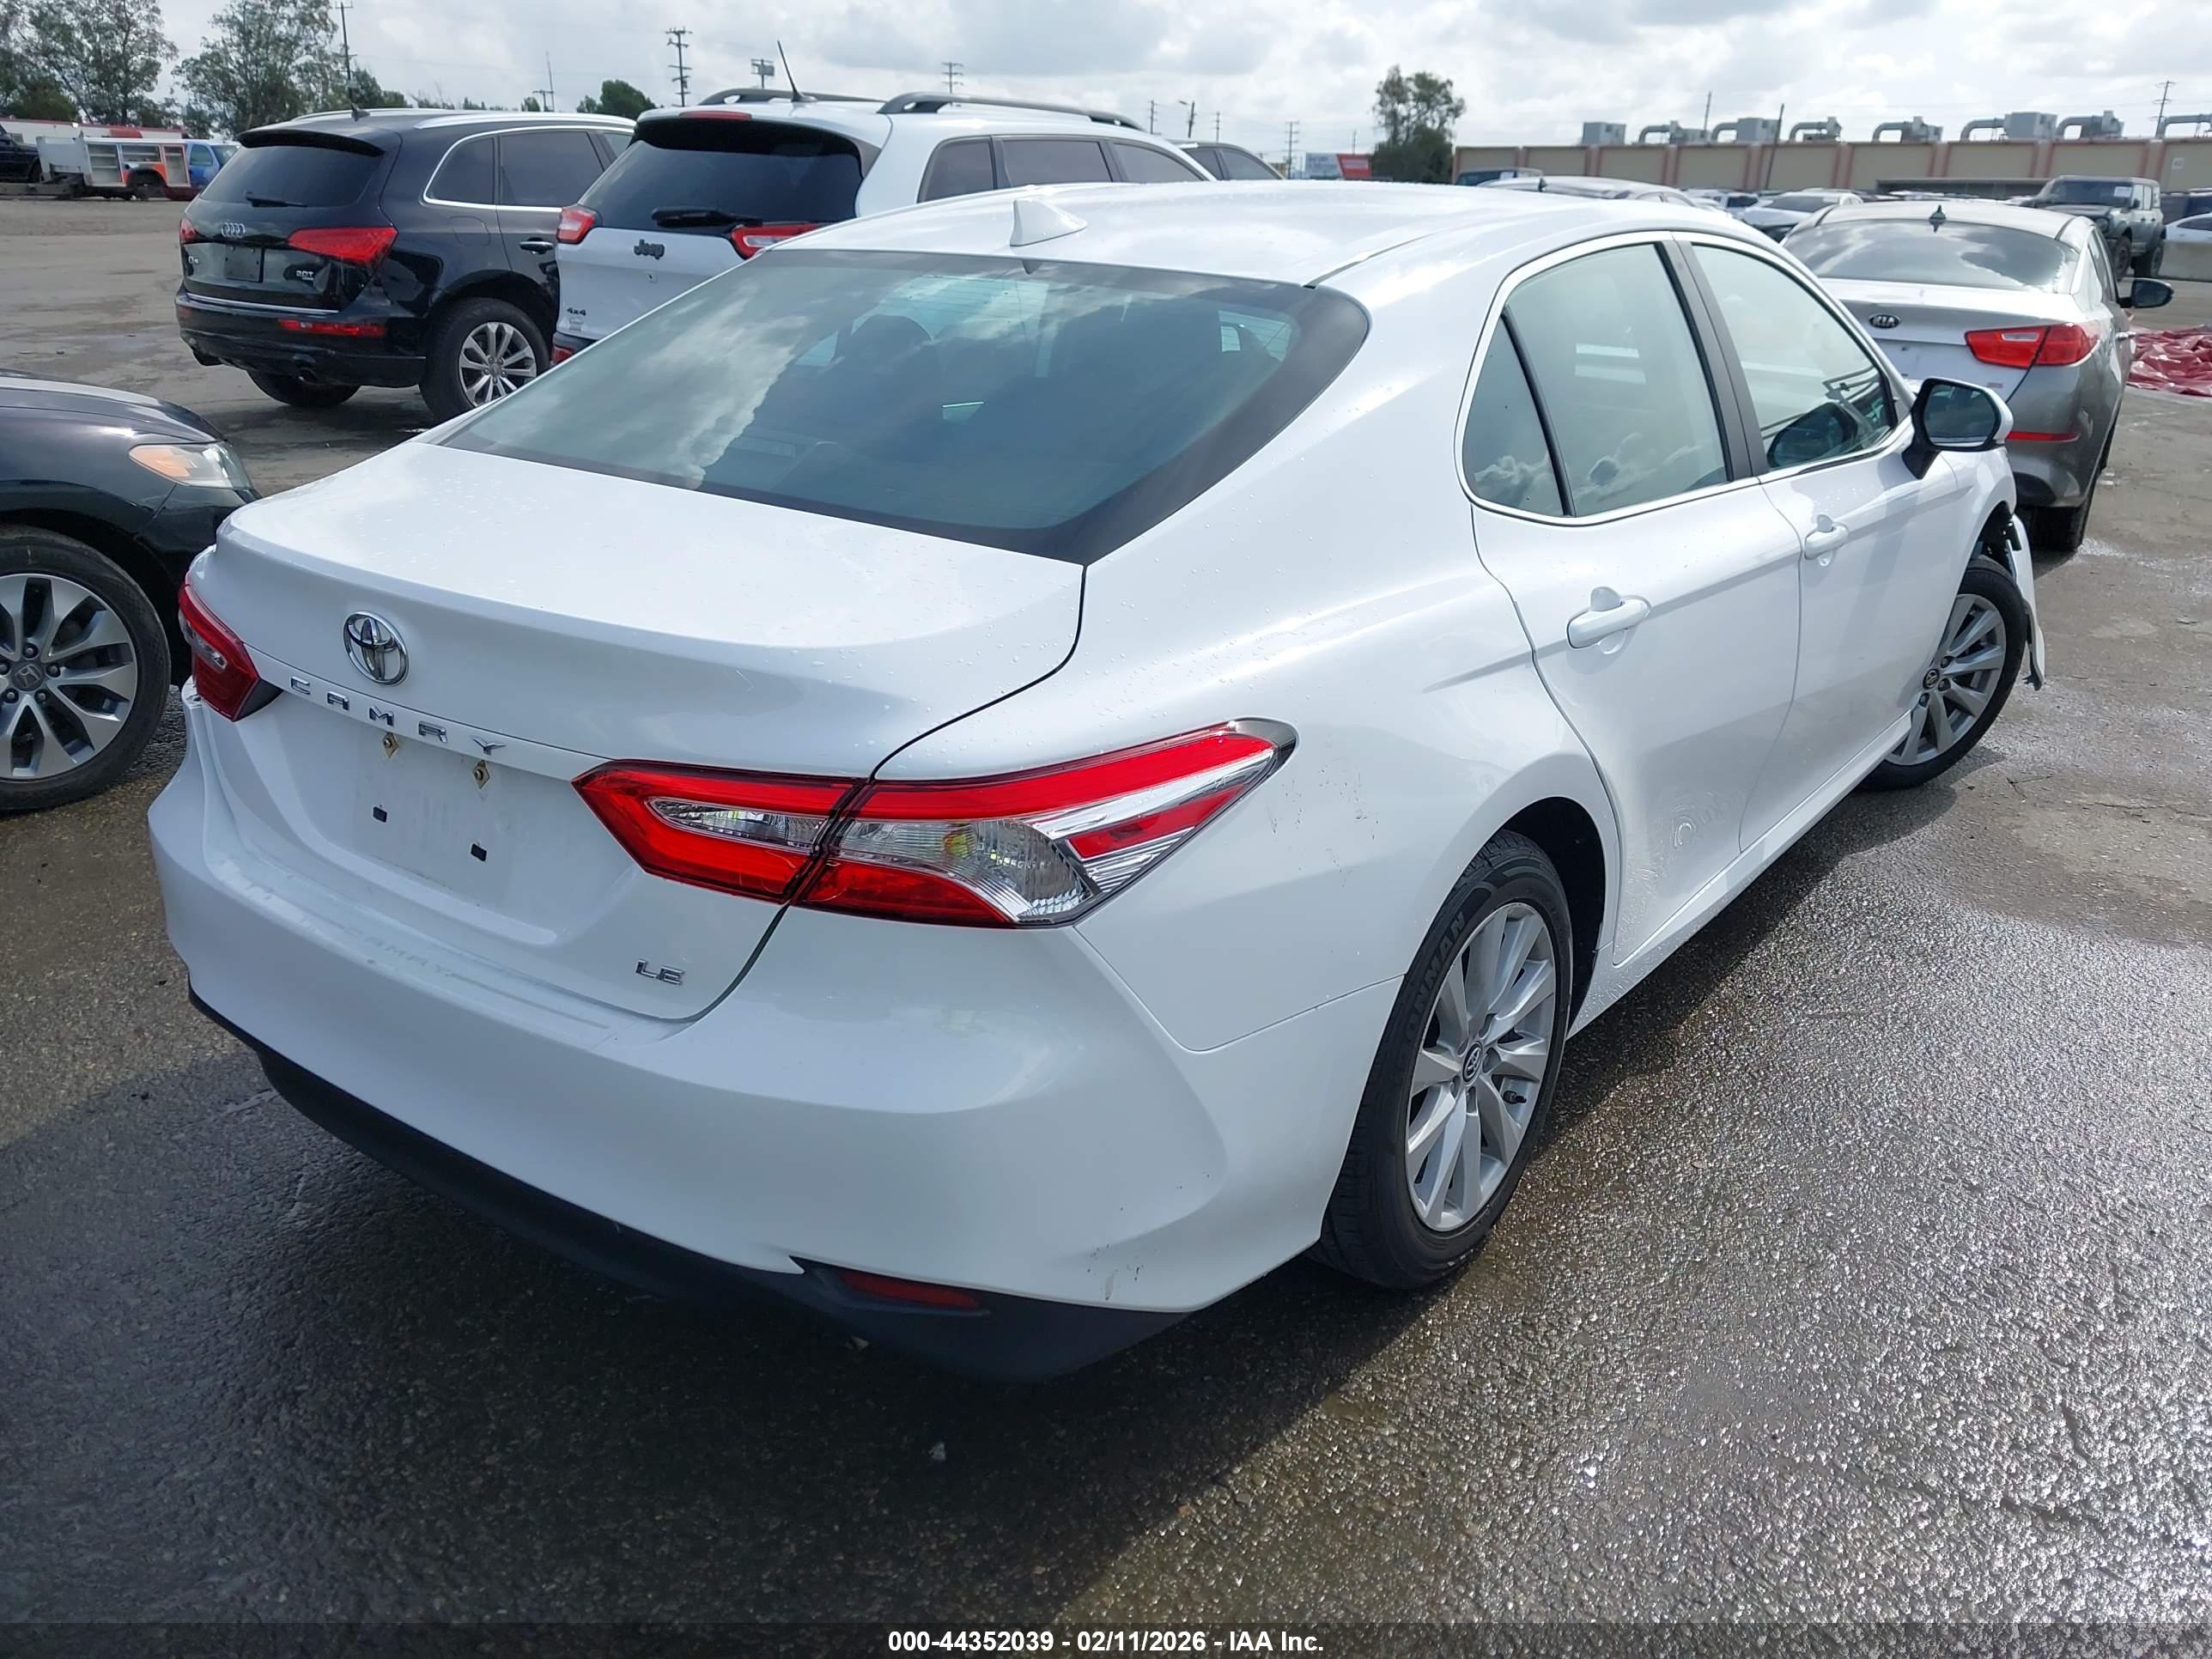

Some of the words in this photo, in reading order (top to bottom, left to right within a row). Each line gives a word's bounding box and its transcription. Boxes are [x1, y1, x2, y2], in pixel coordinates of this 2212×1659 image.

[634, 239, 665, 260] Jeep
[567, 307, 586, 316] 4x4
[1870, 314, 1898, 328] KIA
[290, 675, 507, 756] CAMRY
[635, 957, 685, 986] LE
[1388, 910, 1466, 1080] ONMAN
